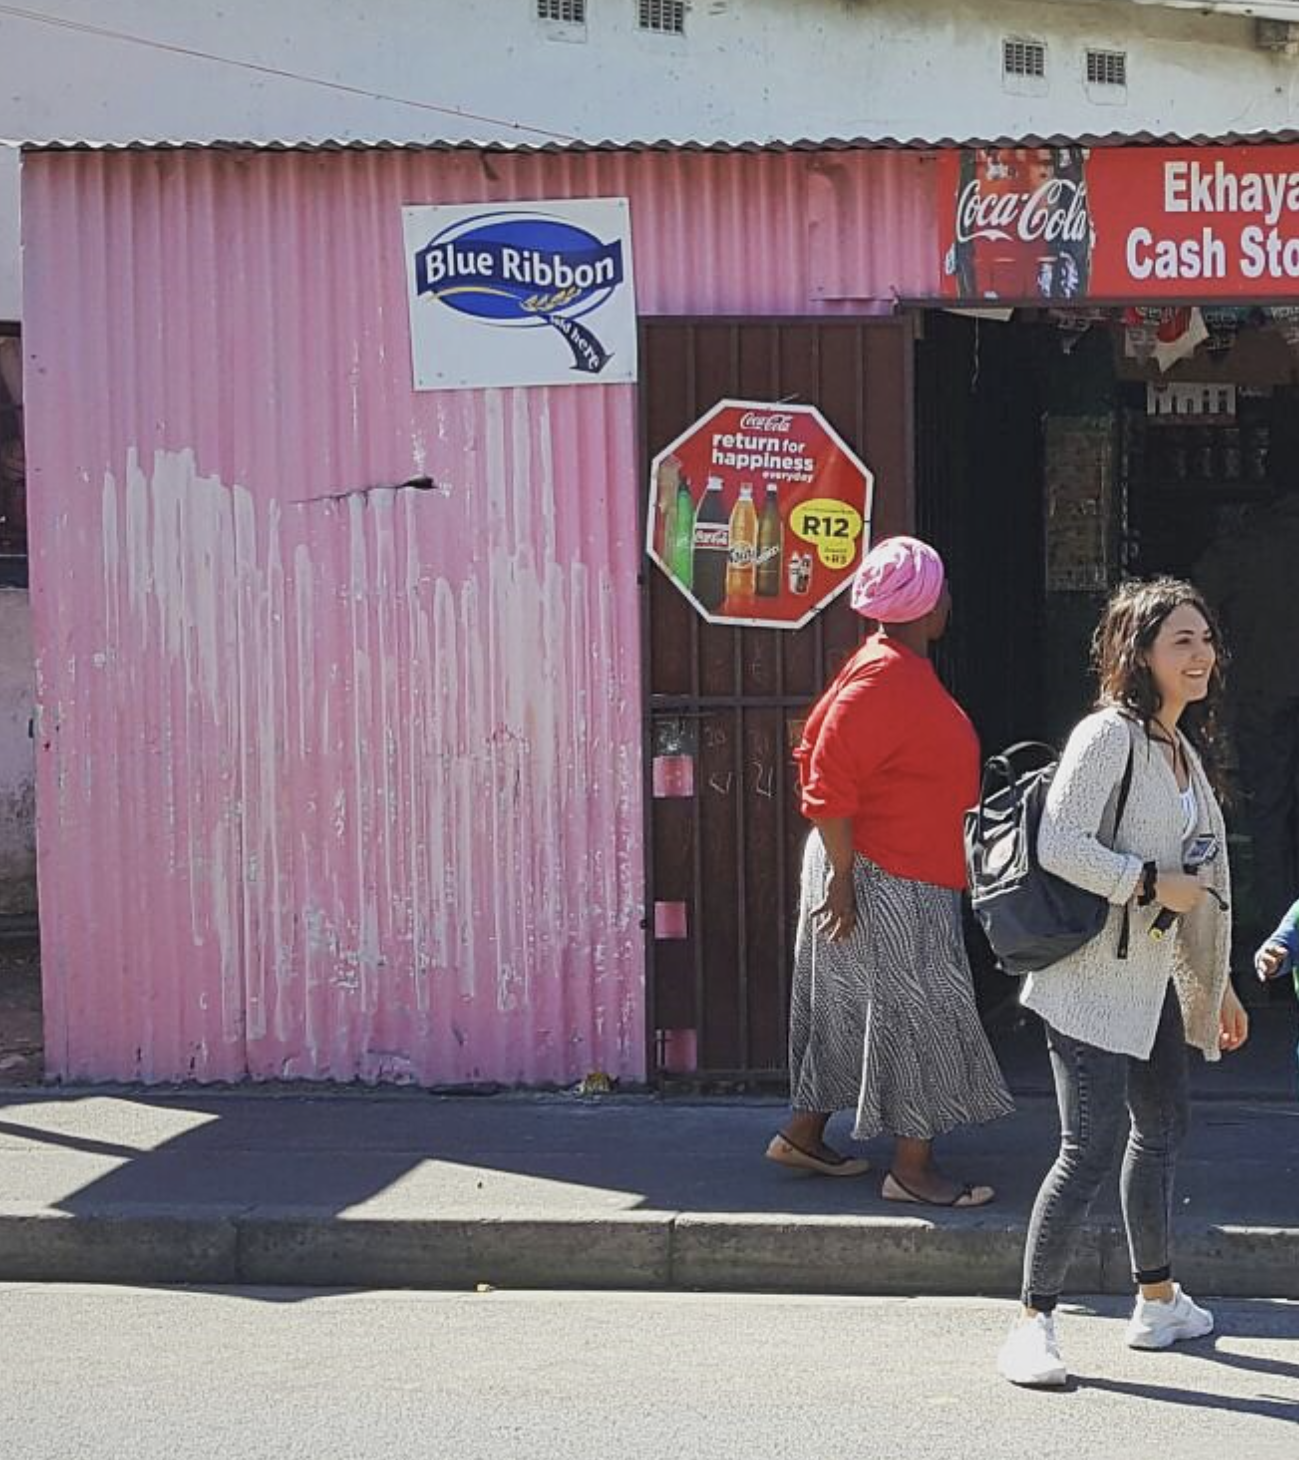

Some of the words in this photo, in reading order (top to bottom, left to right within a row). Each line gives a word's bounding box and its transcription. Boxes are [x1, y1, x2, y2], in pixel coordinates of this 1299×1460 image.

[424, 243, 493, 284] Blue
[502, 248, 614, 288] Ribbon
[1126, 226, 1226, 279] Cash
[570, 327, 601, 370] here
[712, 432, 780, 452] return
[782, 438, 806, 453] for
[711, 448, 814, 472] happiness
[802, 514, 849, 537] R12
